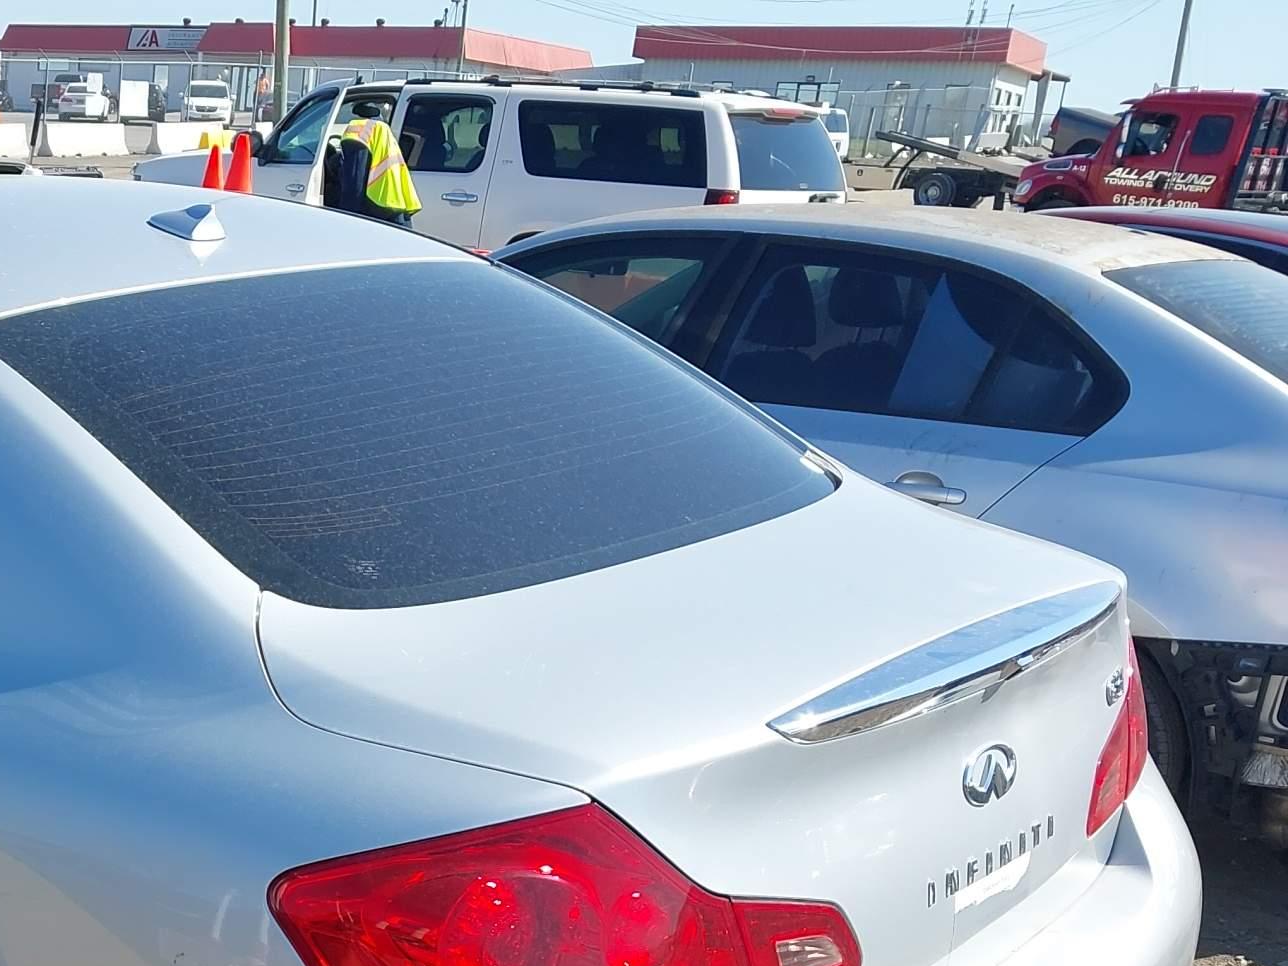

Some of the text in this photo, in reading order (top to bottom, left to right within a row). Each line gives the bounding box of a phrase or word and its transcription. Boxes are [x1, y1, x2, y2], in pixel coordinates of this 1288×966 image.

[1107, 167, 1139, 179] ALL
[1103, 176, 1145, 187] TOWING
[1157, 183, 1211, 193] OVERY
[927, 815, 1054, 908] INFINITI
